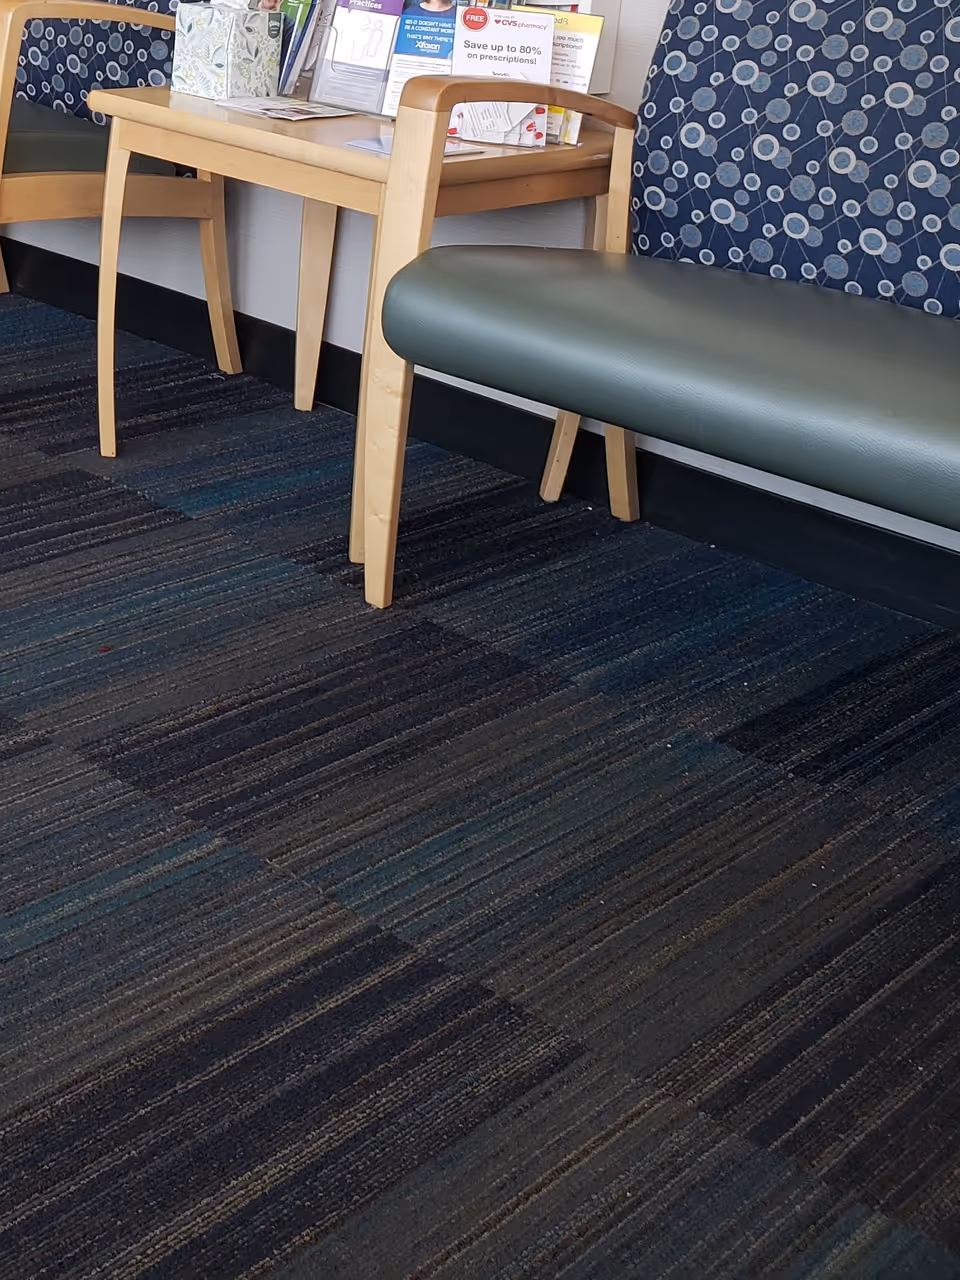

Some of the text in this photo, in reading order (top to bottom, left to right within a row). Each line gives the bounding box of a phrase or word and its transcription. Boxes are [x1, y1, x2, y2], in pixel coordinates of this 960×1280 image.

[465, 14, 485, 23] FREE
[501, 19, 549, 31] CVS pharmacy
[463, 39, 542, 56] Save up to 80%
[479, 53, 537, 65] prescriptions!
